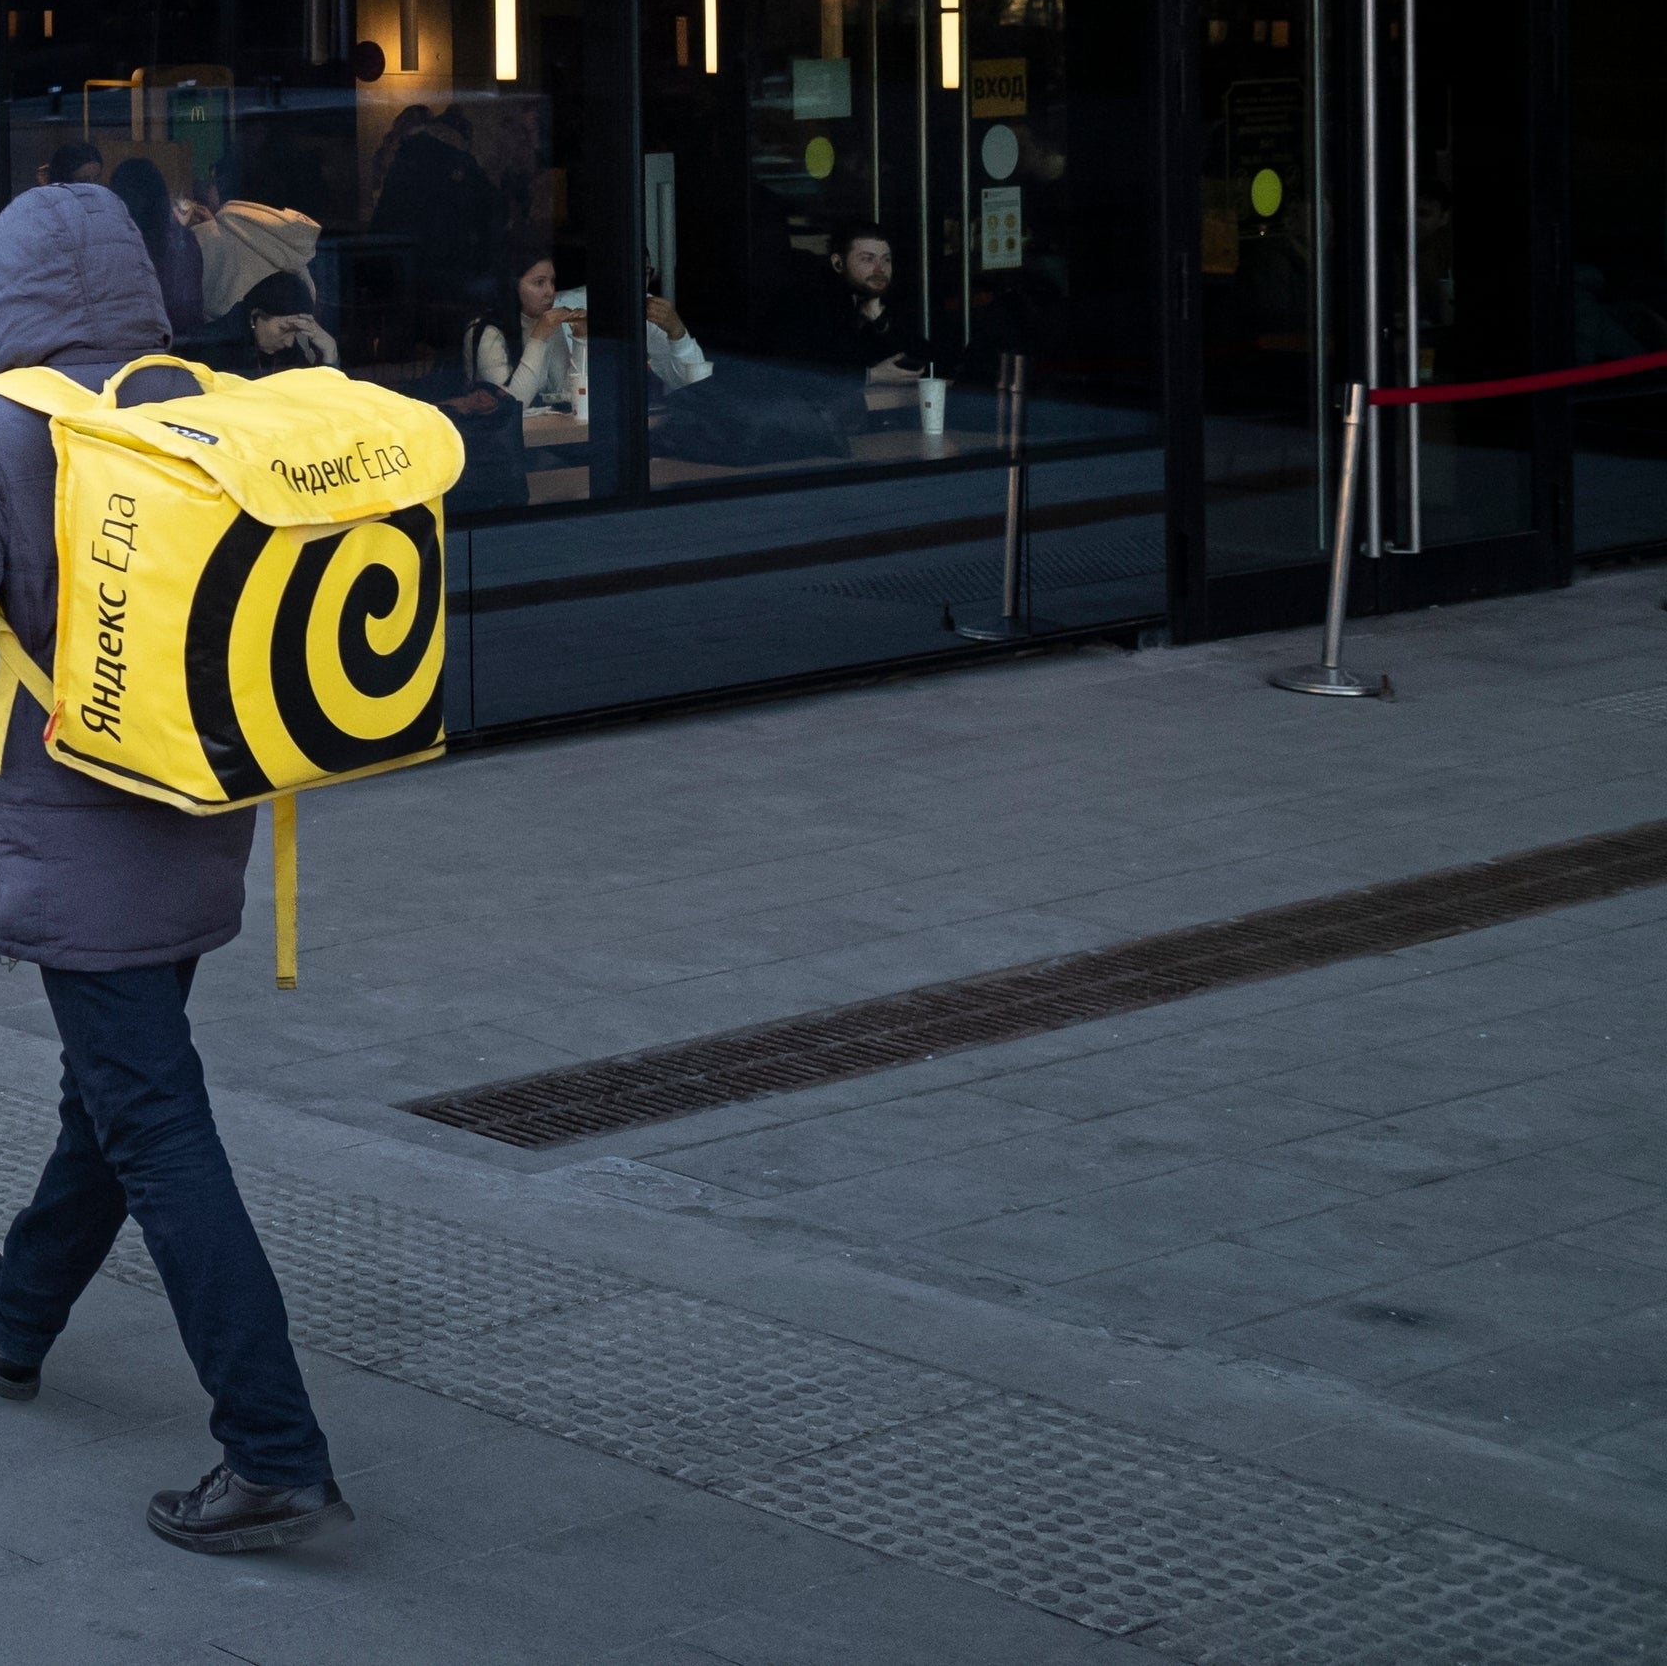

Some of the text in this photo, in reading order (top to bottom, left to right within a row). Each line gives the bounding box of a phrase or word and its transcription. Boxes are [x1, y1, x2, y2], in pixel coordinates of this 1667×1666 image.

[974, 76, 1025, 101] ВХОД
[270, 441, 411, 496] Яндекс Еда
[81, 493, 138, 744] Яндекс Еда
